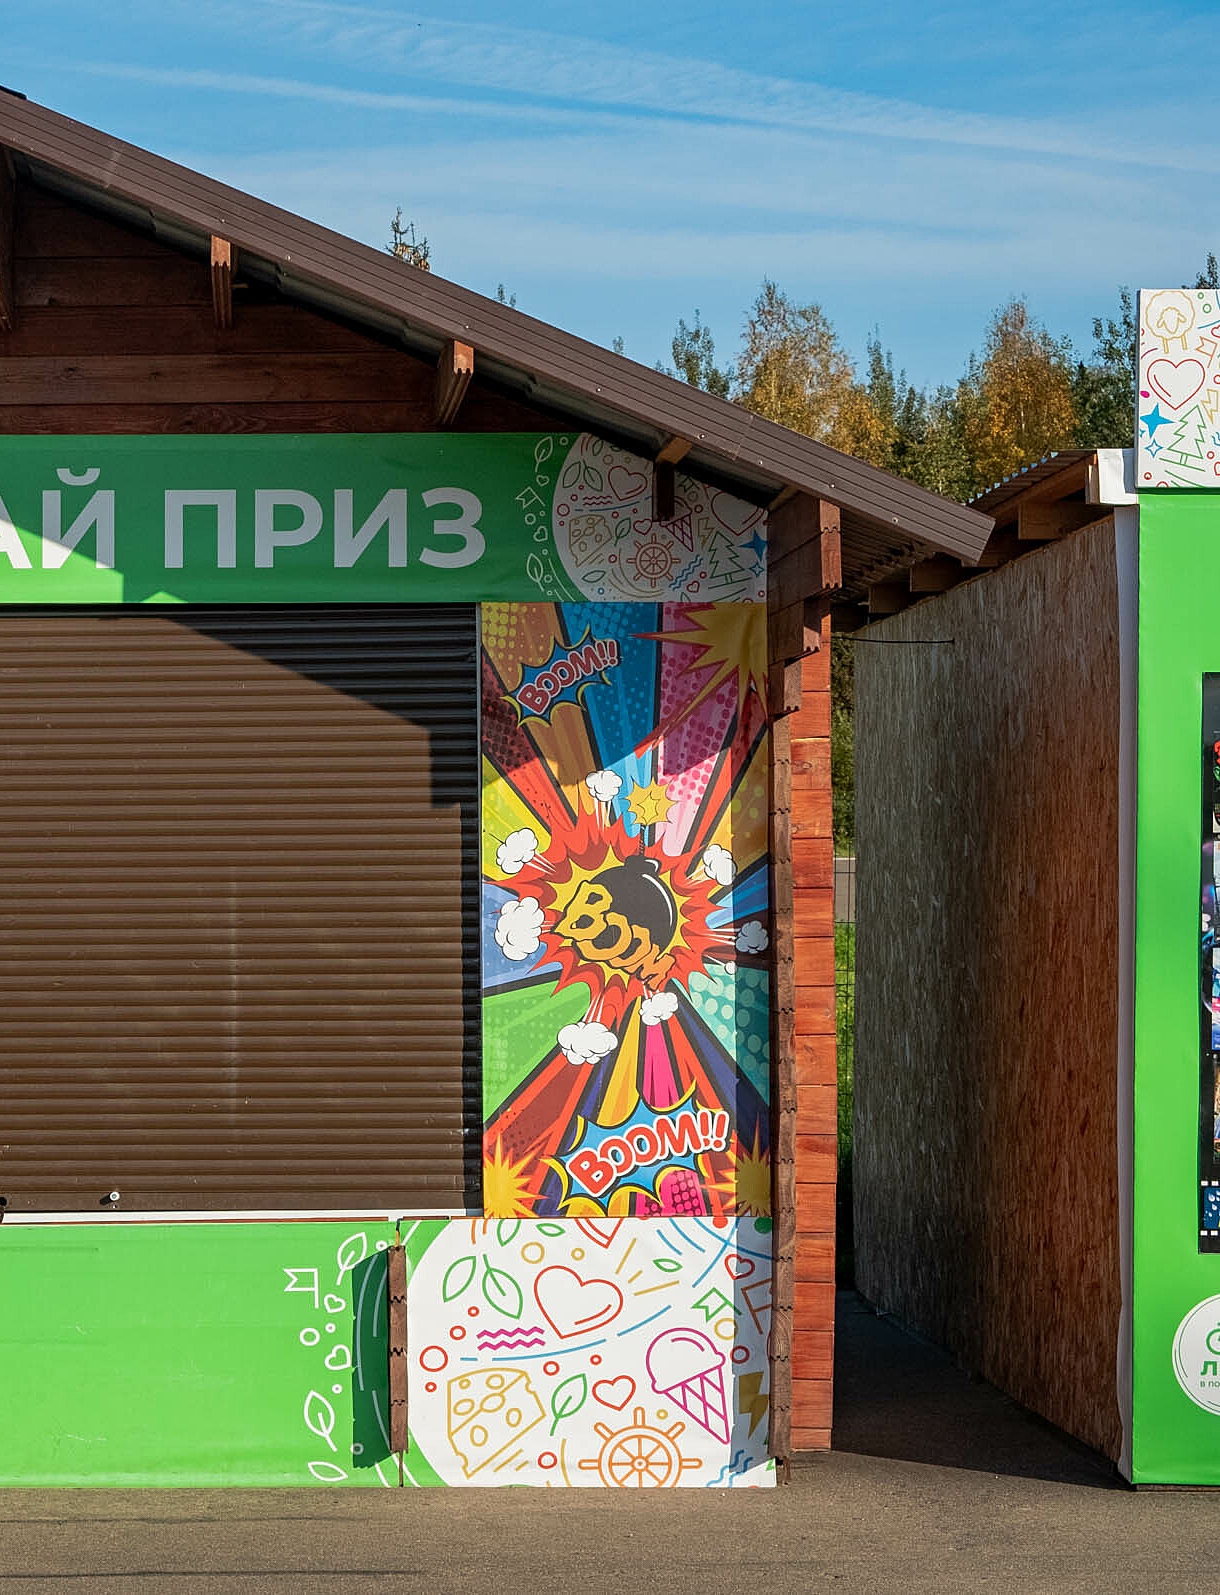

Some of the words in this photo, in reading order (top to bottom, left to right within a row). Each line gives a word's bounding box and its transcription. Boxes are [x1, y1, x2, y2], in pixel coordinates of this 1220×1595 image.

[164, 488, 486, 569] ПРИЗ
[517, 640, 619, 715] BOOM!!
[552, 880, 676, 990] BOOM
[566, 1109, 730, 1197] BOOM!!
